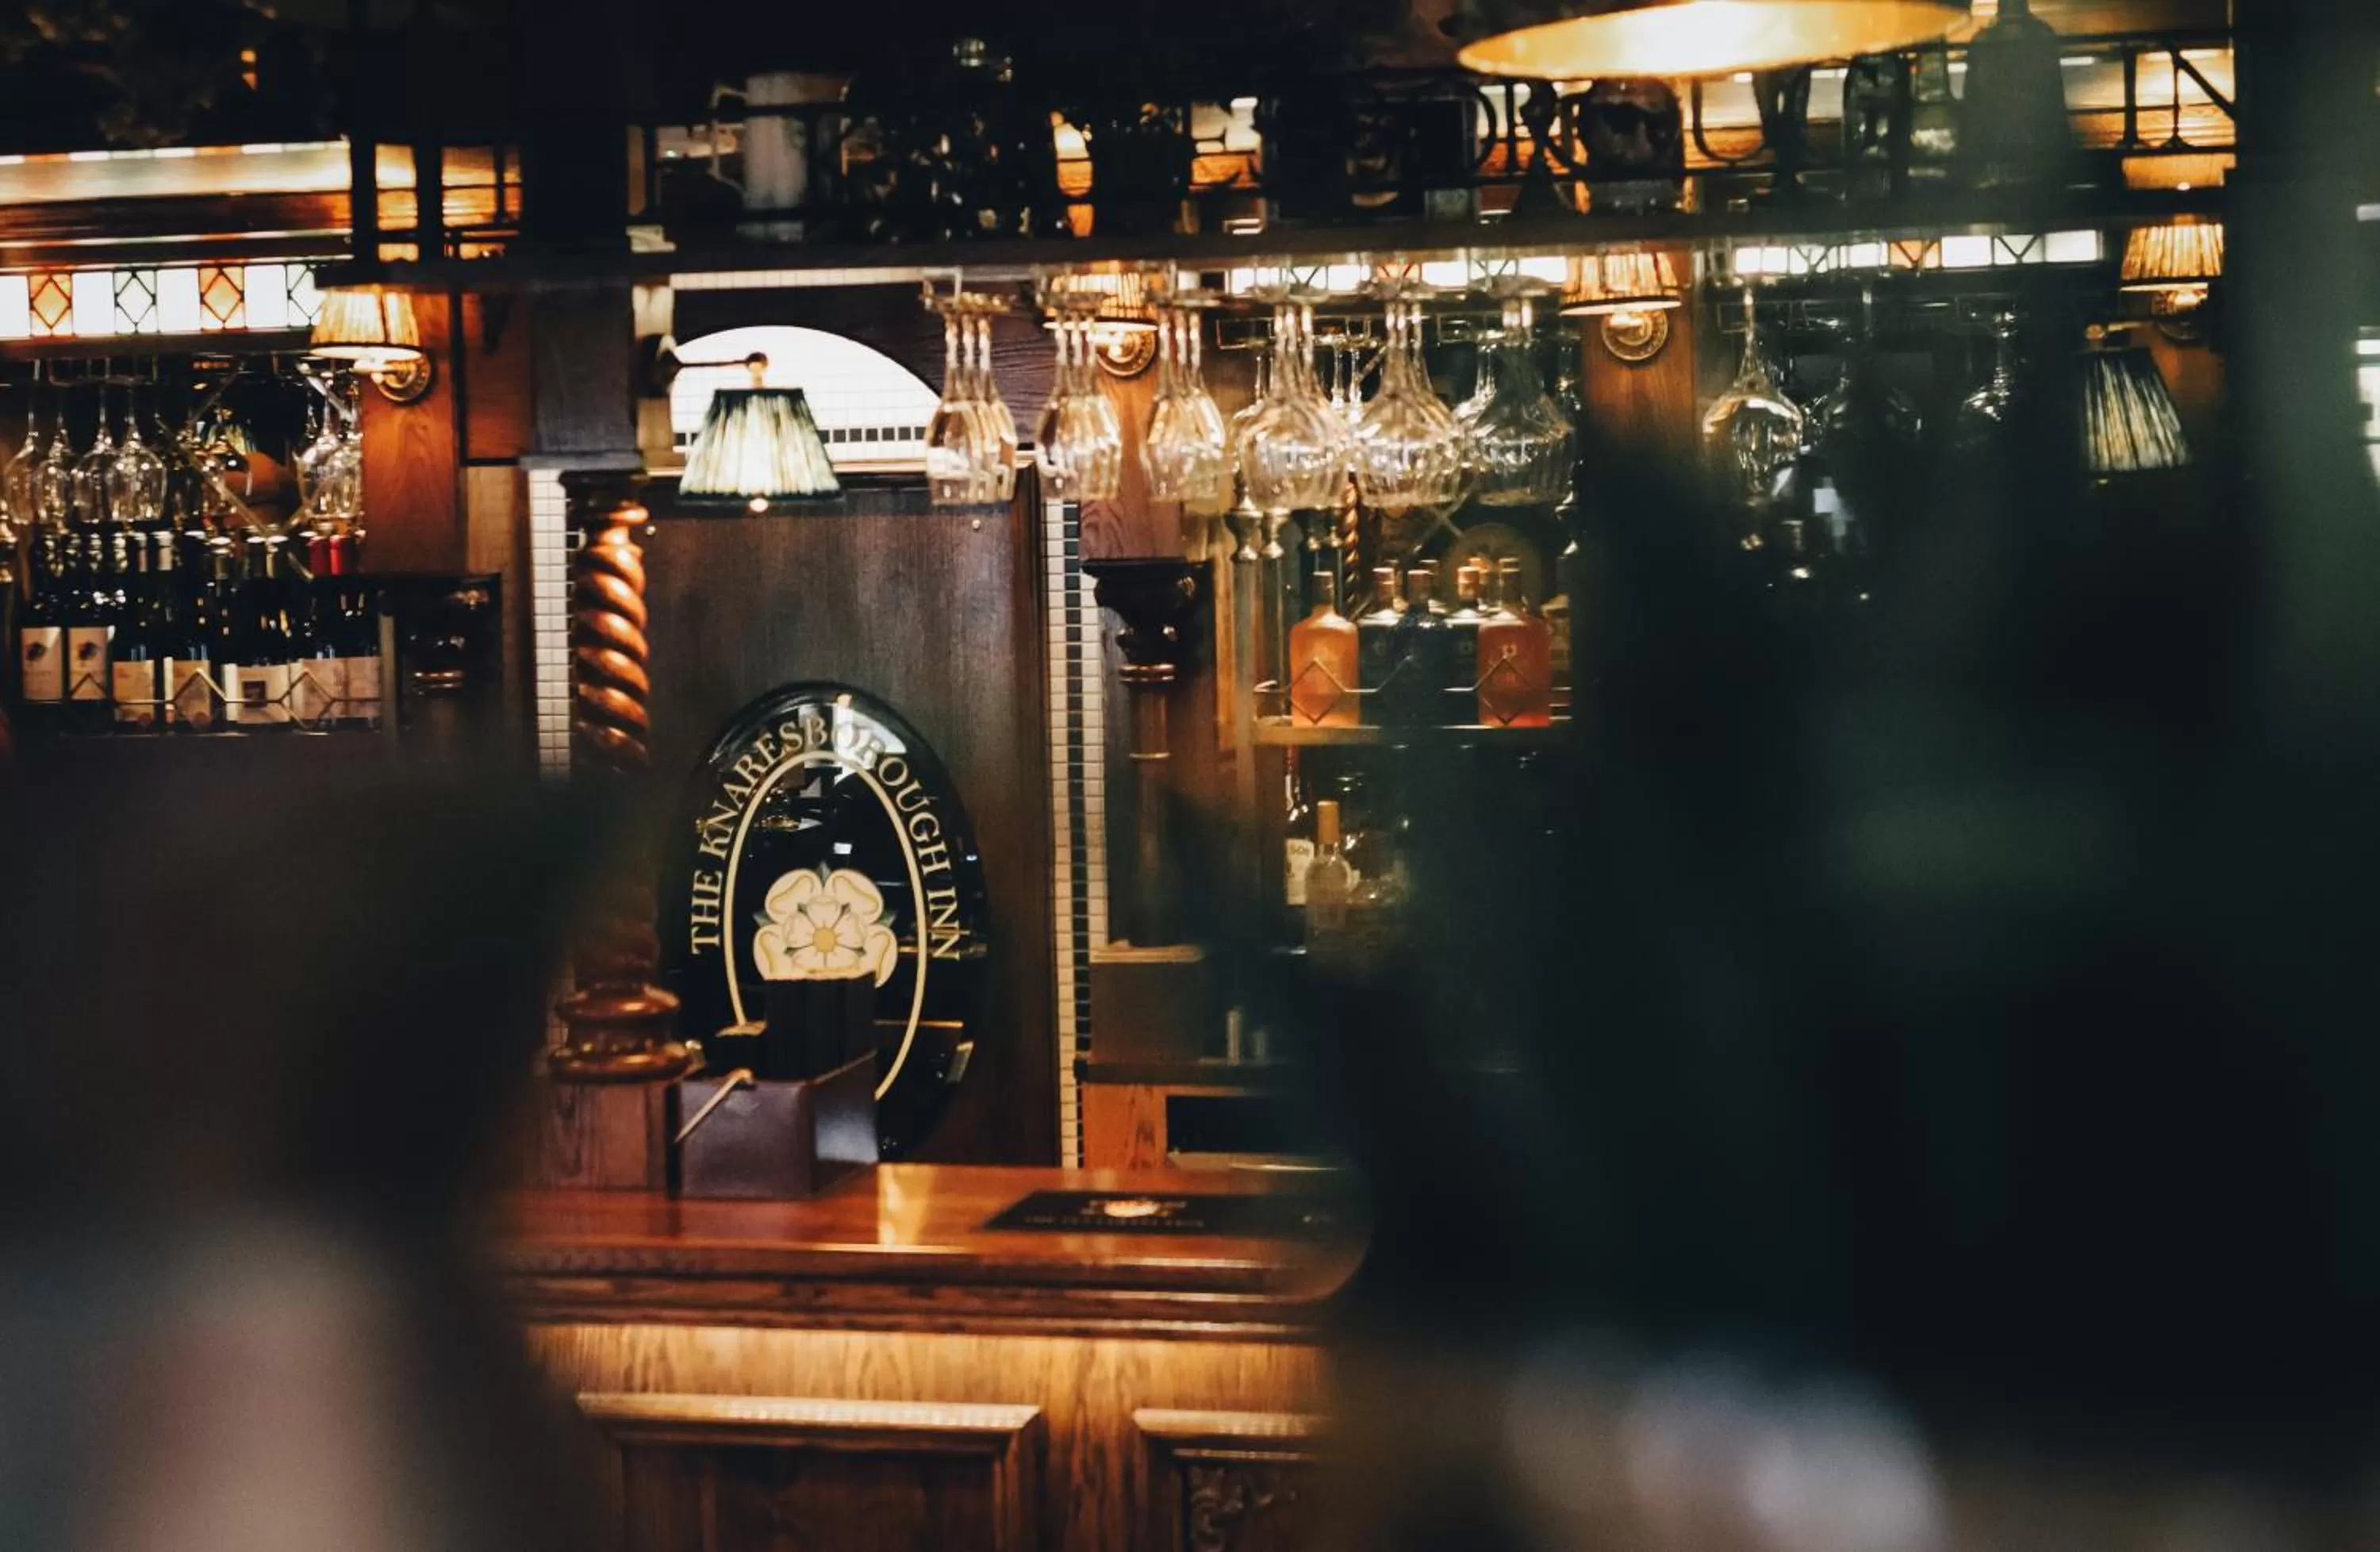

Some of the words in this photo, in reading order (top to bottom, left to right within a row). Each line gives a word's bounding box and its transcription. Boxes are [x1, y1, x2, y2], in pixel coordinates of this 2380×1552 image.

[699, 717, 951, 875] KNARESBOROUGH
[692, 870, 722, 954] THE
[927, 887, 961, 961] INN
